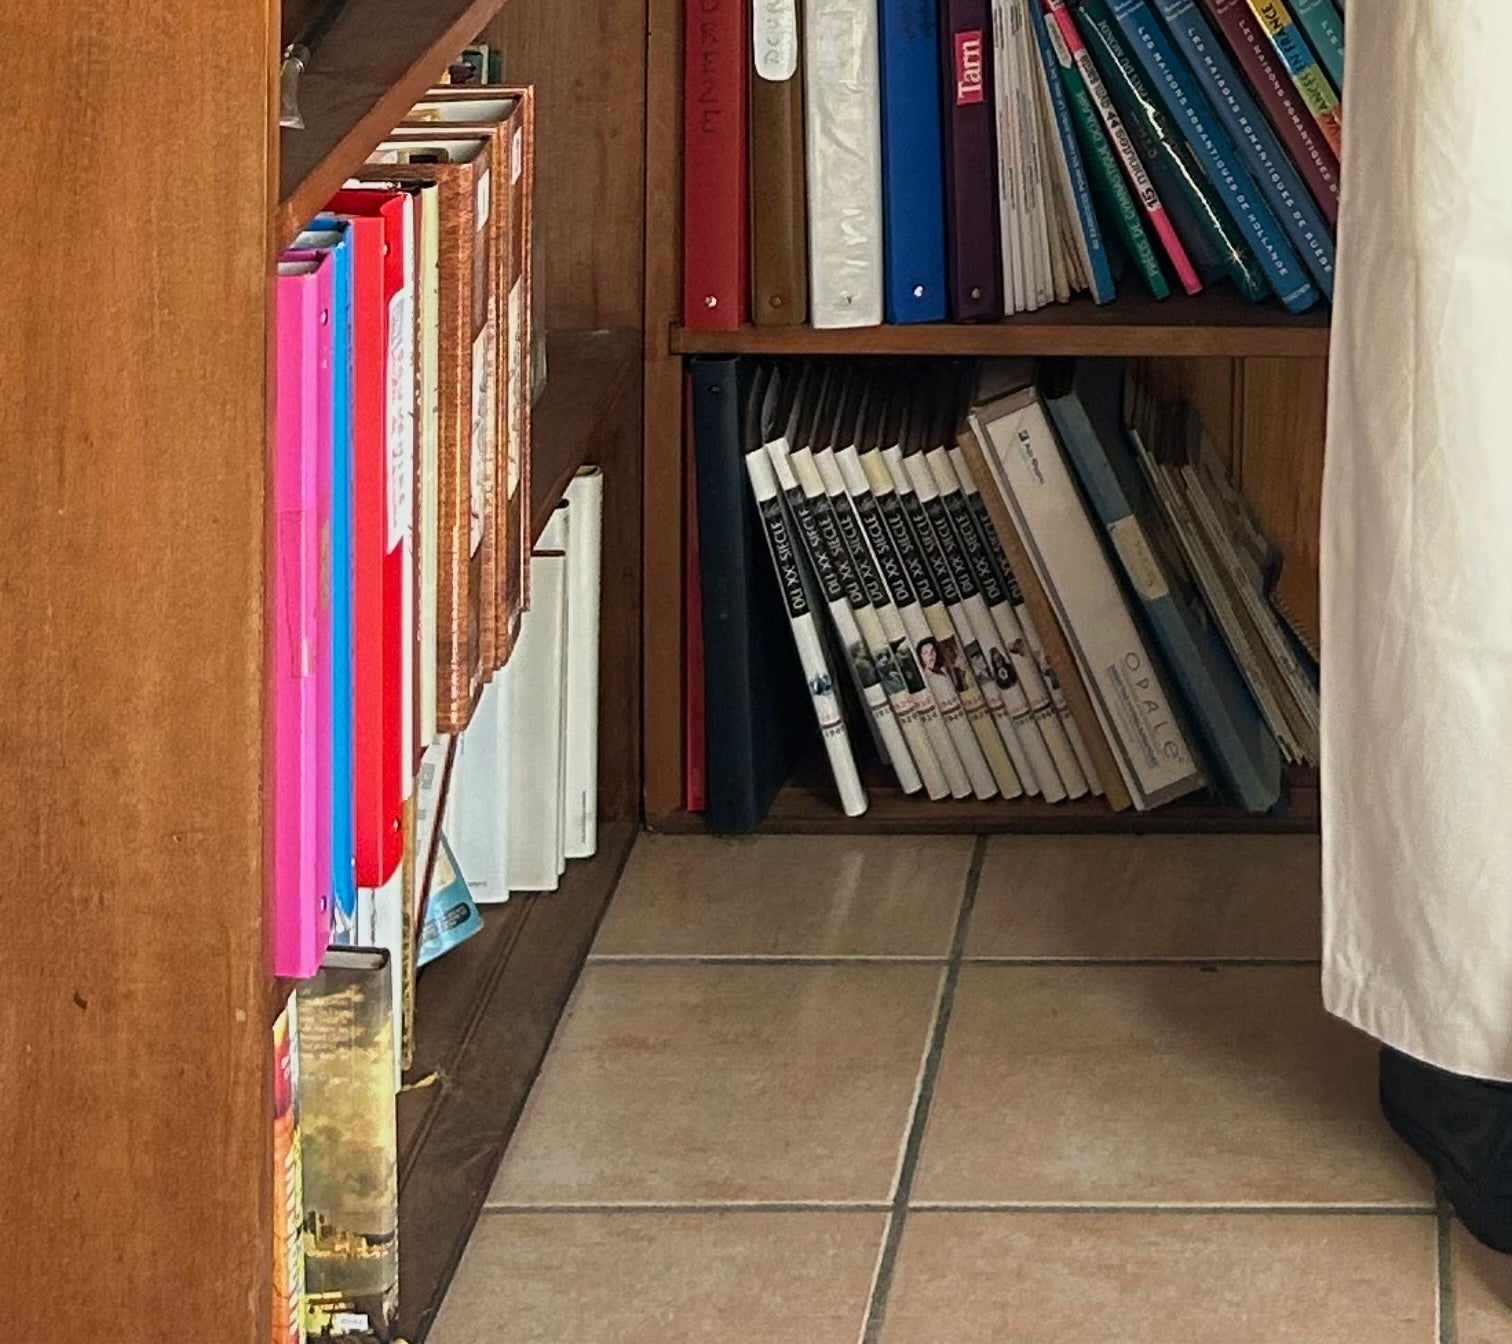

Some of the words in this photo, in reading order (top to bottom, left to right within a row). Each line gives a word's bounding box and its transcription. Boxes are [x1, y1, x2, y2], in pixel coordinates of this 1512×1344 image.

[1260, 1, 1298, 55] FRANCE
[1320, 19, 1340, 45] LES
[958, 38, 982, 98] Tarn
[1289, 52, 1307, 73] EN
[1237, 18, 1257, 44] LES
[1251, 44, 1286, 99] MAISONS
[1281, 97, 1333, 183] ROMANTIQUES
[1297, 69, 1346, 141] VACANCES
[1110, 127, 1148, 188] minutes
[1136, 25, 1155, 51] LES
[1152, 50, 1188, 108] MAISONS
[1184, 104, 1240, 196] ROMANTIQUES
[1235, 192, 1251, 212] DE
[1247, 210, 1290, 279] HOLLANDE
[1186, 26, 1206, 53] LES
[1203, 54, 1242, 115] MAISONS
[1238, 114, 1296, 209] ROMANTIQUES
[1291, 209, 1308, 229] DE
[1304, 229, 1335, 275] SUÈDE
[1093, 142, 1139, 223] GYMNASTIQUE
[1140, 186, 1161, 210] 15
[1128, 220, 1145, 240] DE
[1134, 237, 1162, 278] PRÉCIS
[825, 574, 841, 594] DU
[845, 582, 862, 603] DU
[867, 581, 884, 601] DU
[892, 579, 910, 600] DU
[917, 578, 934, 601] DU
[941, 578, 957, 599] DU
[958, 572, 974, 594] DU
[984, 578, 1000, 600] DU
[792, 589, 807, 610] DU
